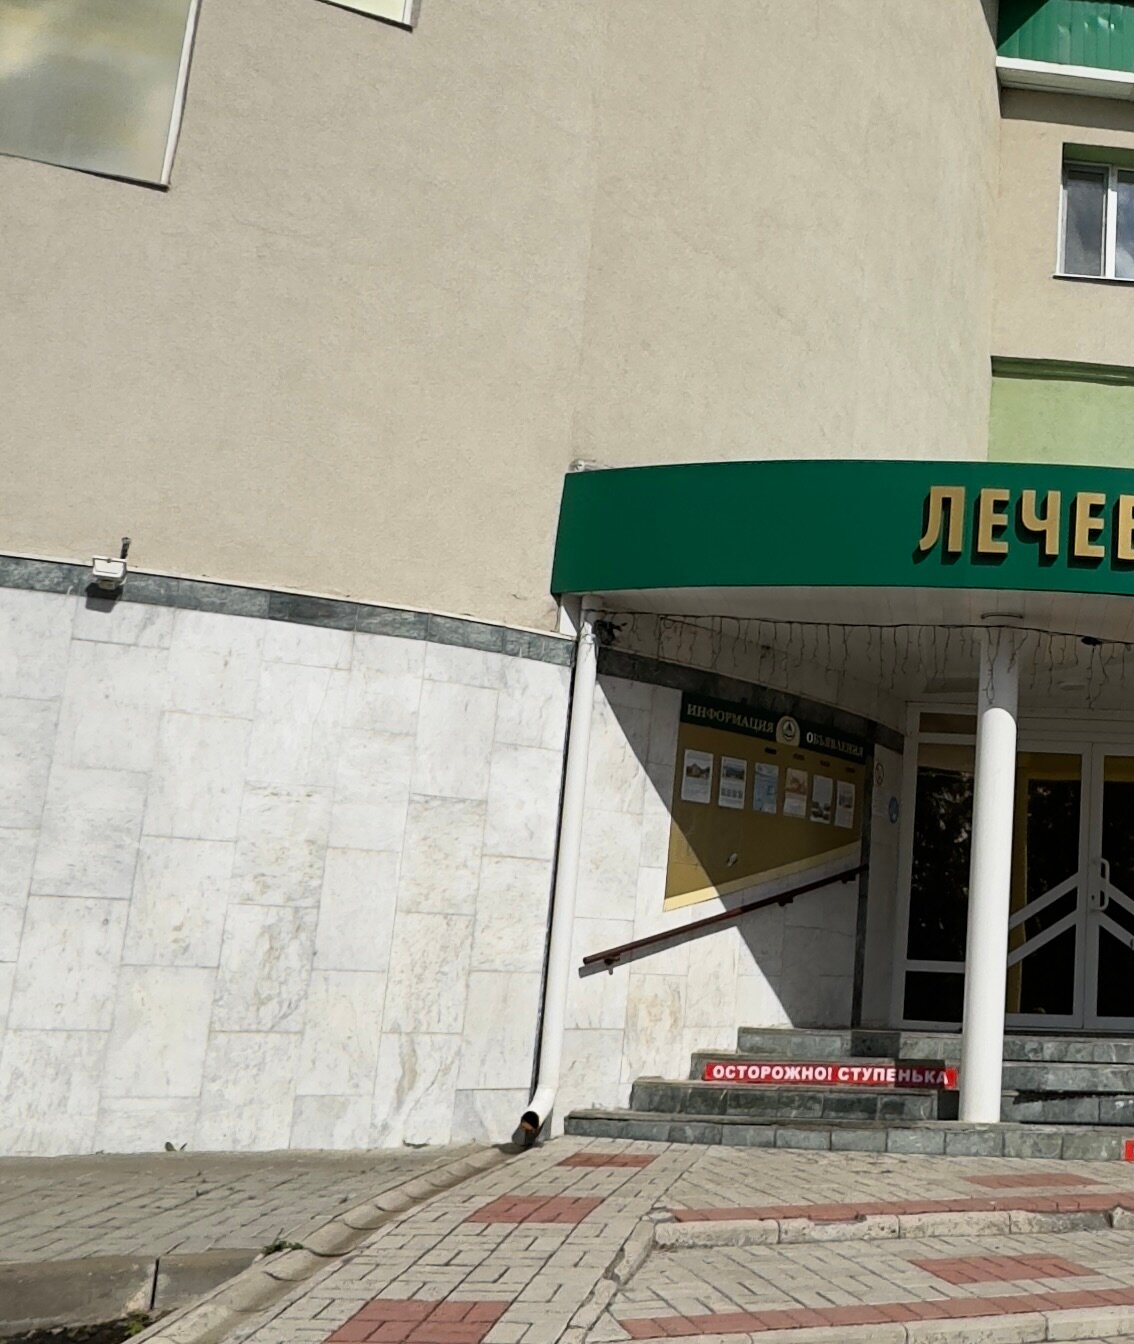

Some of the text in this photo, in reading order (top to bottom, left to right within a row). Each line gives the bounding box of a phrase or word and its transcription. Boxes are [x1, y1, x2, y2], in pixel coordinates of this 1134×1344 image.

[687, 704, 774, 733] ИНФОРМАЦИЯ
[712, 1064, 949, 1085] ОСТОРОЖНО! СТУПЕНЬКА
